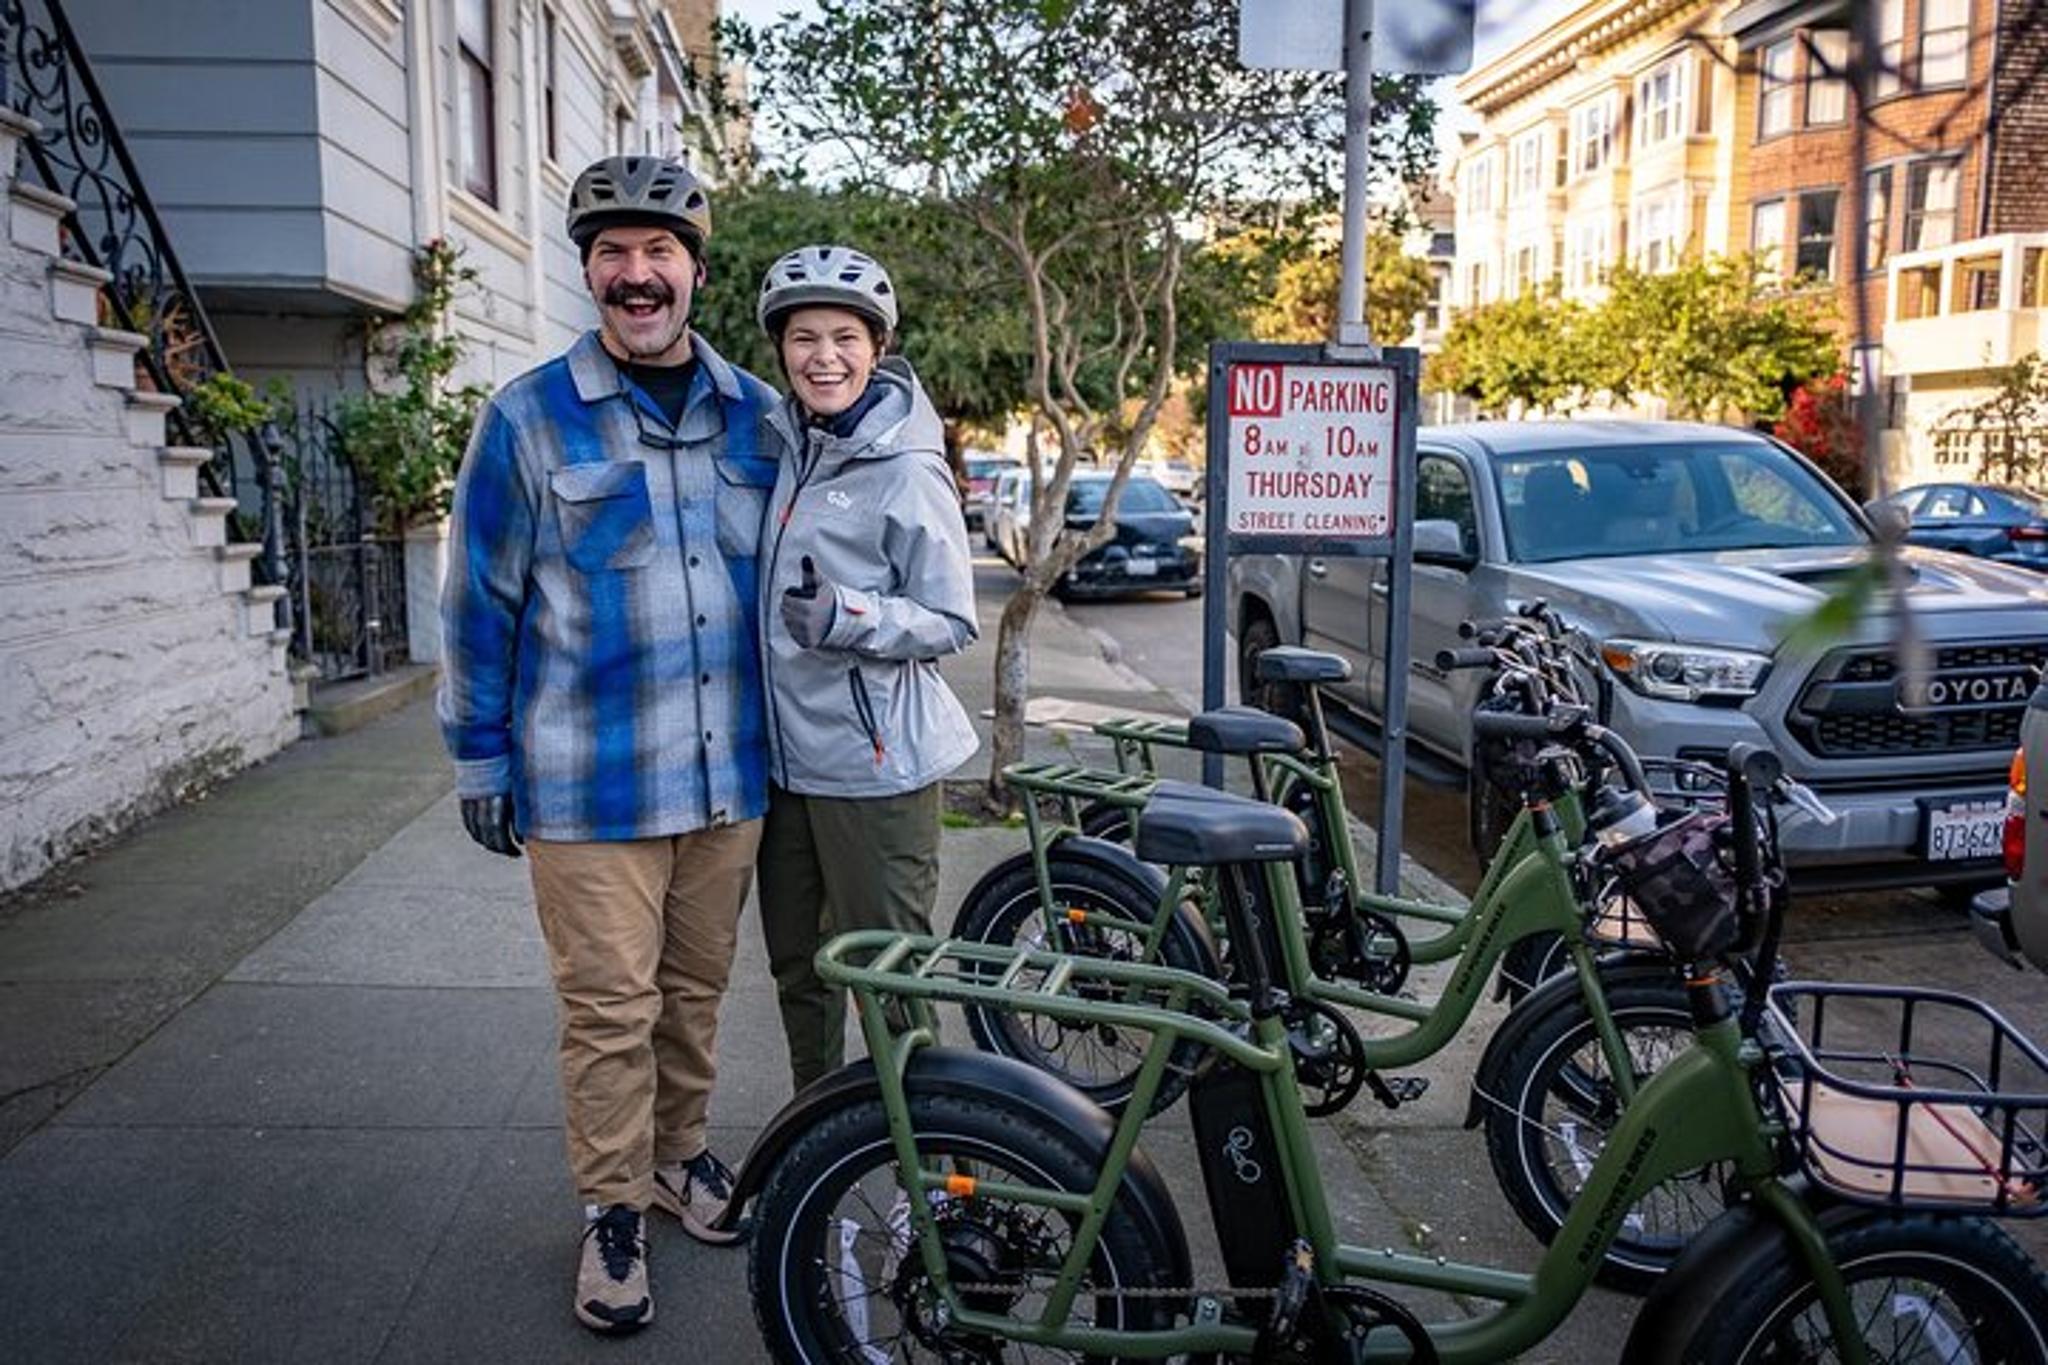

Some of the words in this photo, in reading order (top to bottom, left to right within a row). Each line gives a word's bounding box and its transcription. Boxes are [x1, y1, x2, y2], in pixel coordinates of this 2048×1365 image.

[1234, 367, 1276, 411] NO
[1288, 380, 1388, 413] PARKING
[1247, 471, 1373, 499] THURSDAY
[1239, 511, 1295, 530] STREET
[1303, 514, 1378, 531] CLEANING
[1914, 676, 2028, 704] OYOTA
